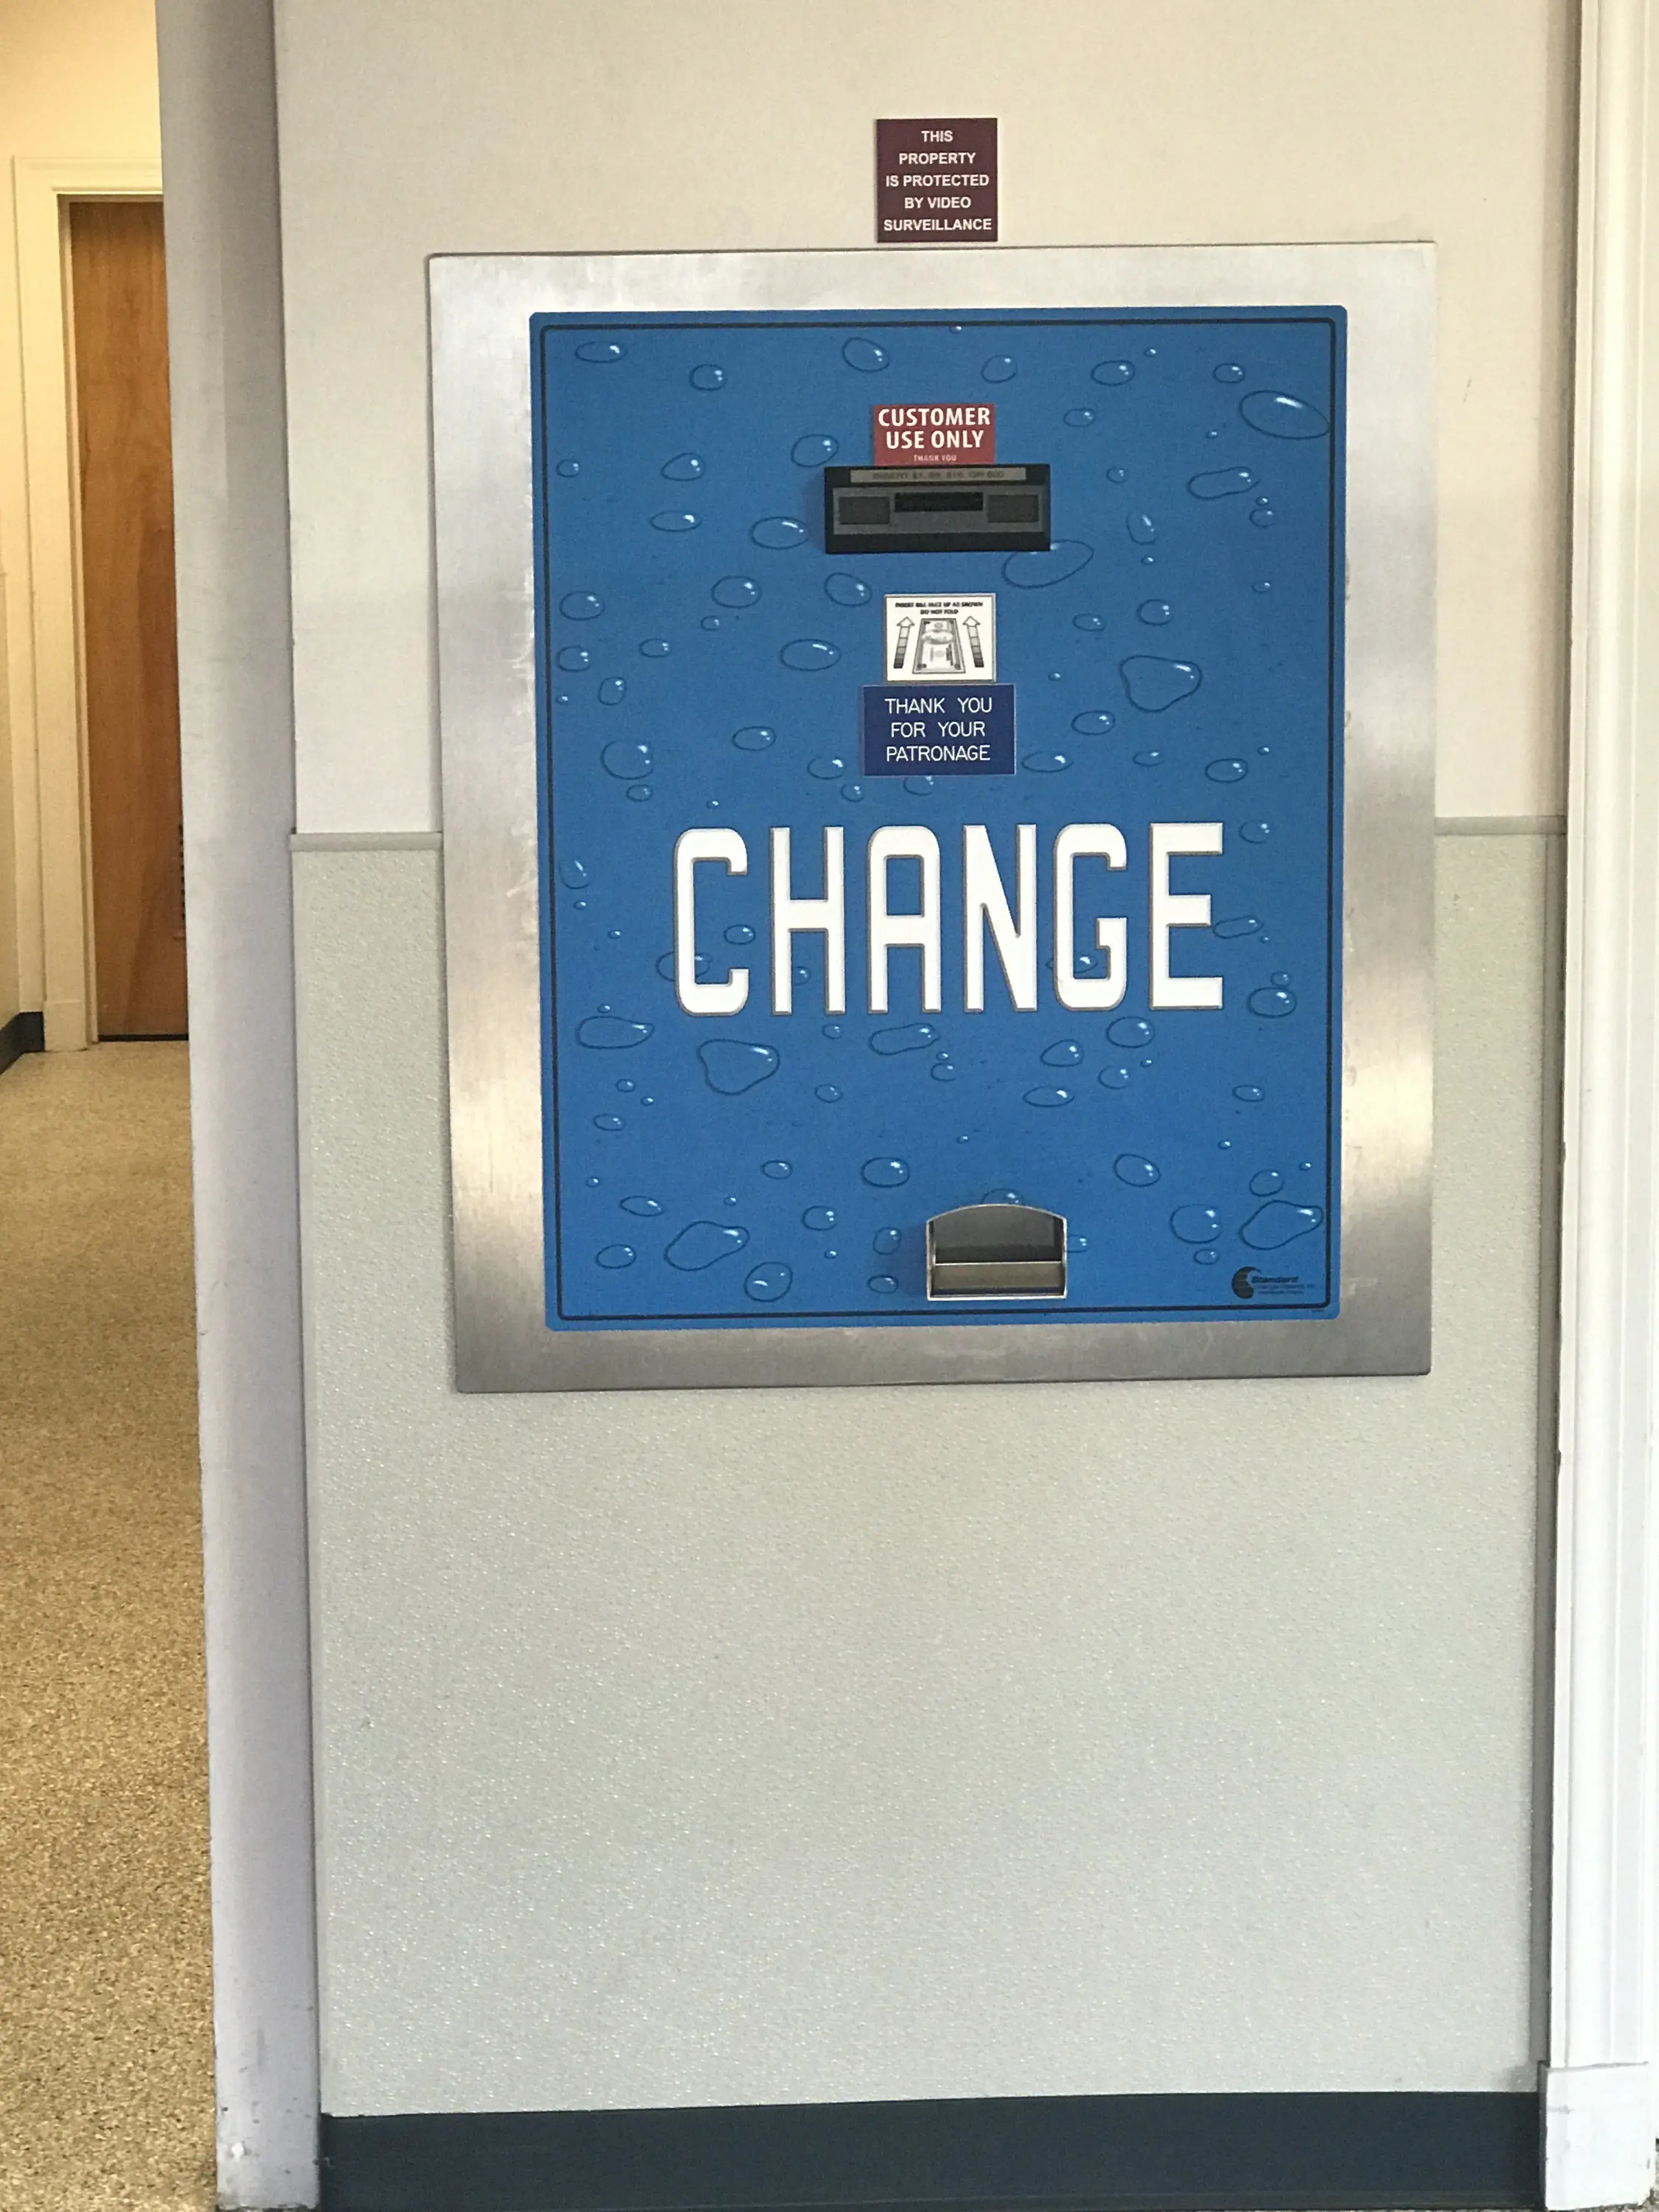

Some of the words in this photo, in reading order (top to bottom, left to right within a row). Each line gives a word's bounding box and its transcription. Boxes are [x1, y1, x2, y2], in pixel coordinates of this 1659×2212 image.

[921, 130, 953, 143] THIS
[899, 152, 976, 165] PROPERTY
[886, 175, 899, 187] IS
[903, 174, 989, 187] PROTECTED
[905, 197, 924, 209] BY
[927, 196, 972, 208] VIDEO
[884, 218, 992, 231] SURVEILLANCE
[878, 407, 990, 427] CUSTOMER
[886, 431, 924, 449] USE
[931, 430, 984, 448] ONLY
[884, 697, 945, 714] THANK
[957, 697, 992, 713] YOU
[891, 721, 926, 738] FOR
[938, 721, 985, 737] YOUR
[886, 744, 991, 762] PATRONAGE
[674, 822, 1223, 1017] CHANGE
